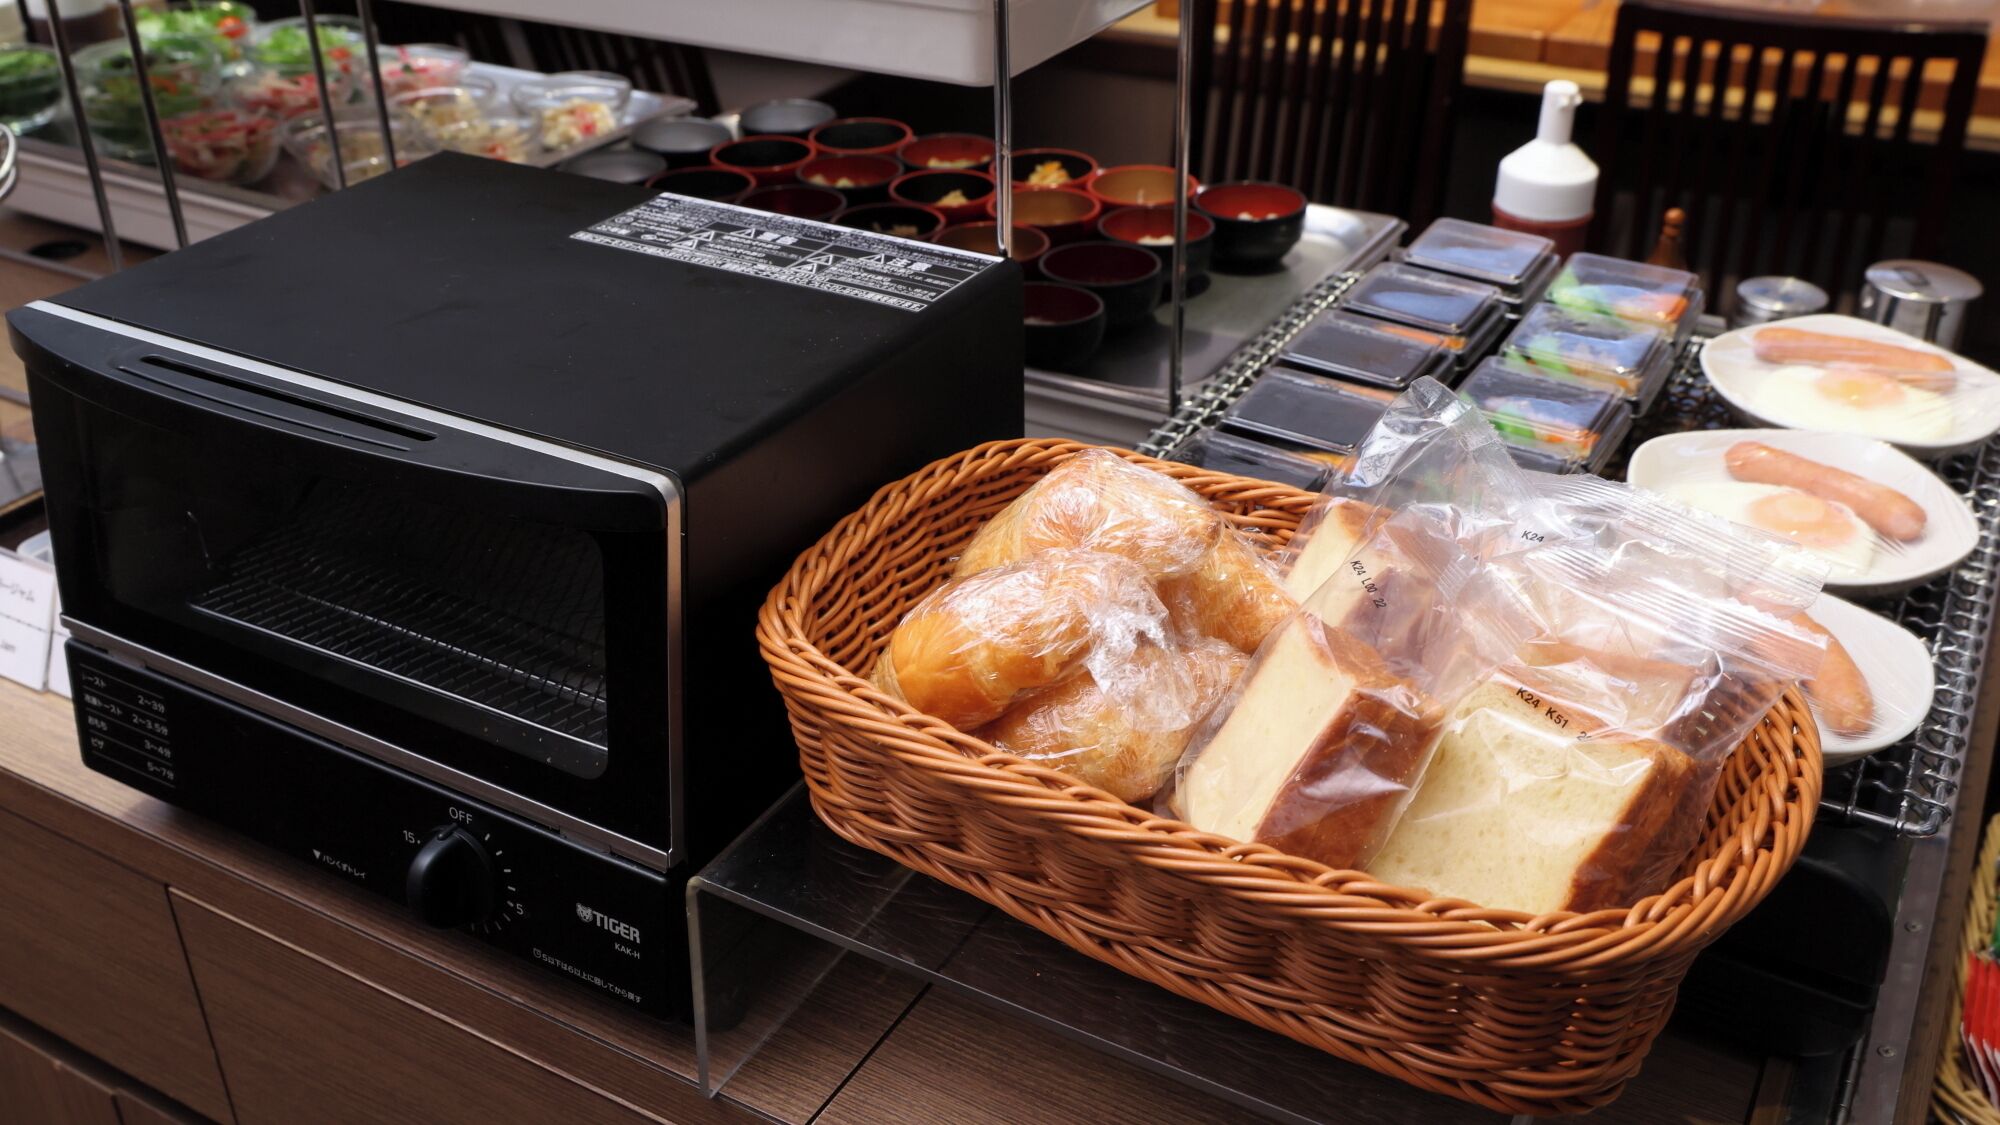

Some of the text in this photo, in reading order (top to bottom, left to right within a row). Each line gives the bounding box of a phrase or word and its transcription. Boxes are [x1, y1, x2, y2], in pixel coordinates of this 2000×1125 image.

[1521, 530, 1545, 543] K24
[1350, 560, 1366, 576] K24
[1516, 686, 1540, 708] K24
[1545, 706, 1569, 729] K51
[449, 807, 473, 824] OFF
[516, 903, 524, 915] 5
[592, 910, 641, 944] TIGER
[615, 942, 641, 959] KAK-H
